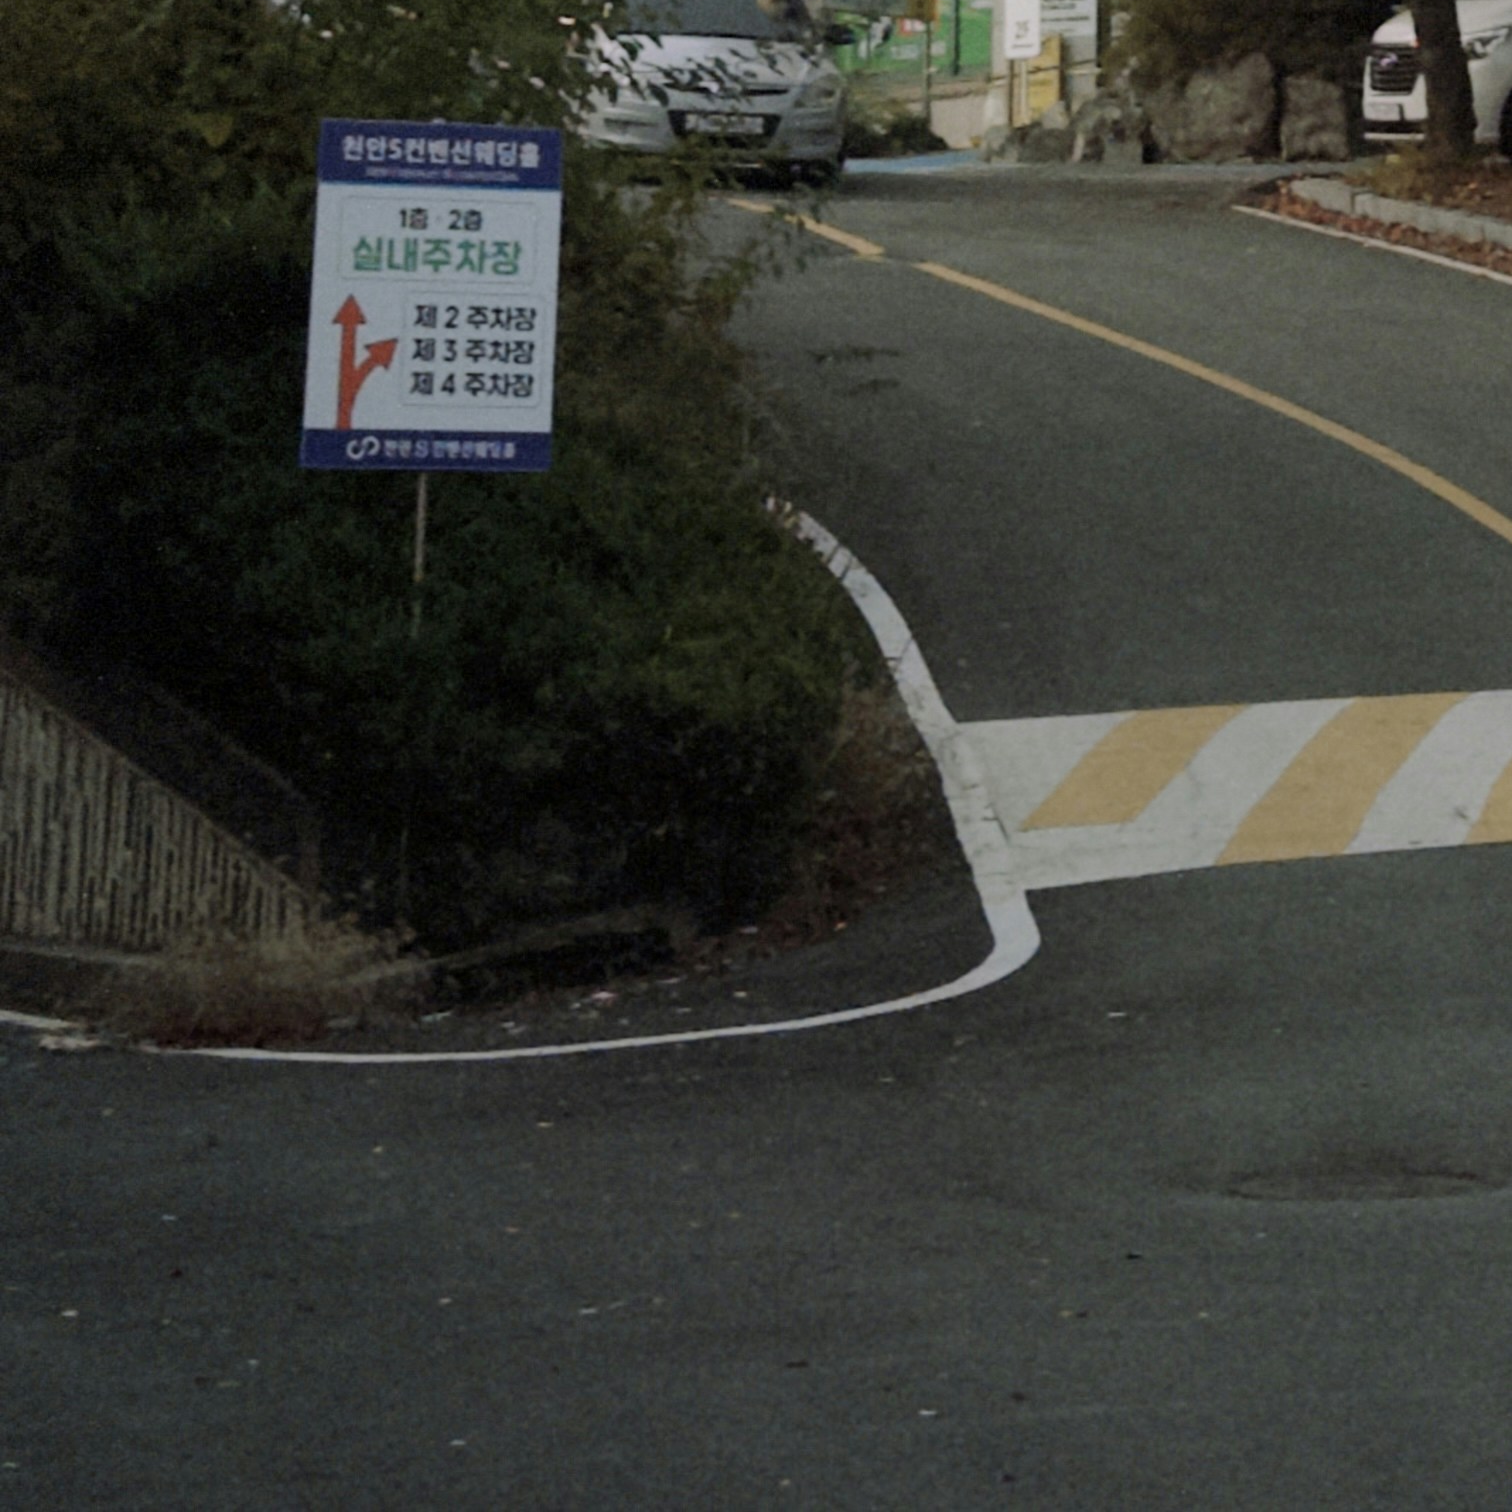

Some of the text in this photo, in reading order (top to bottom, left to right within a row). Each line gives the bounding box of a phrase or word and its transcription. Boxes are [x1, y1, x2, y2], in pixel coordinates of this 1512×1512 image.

[352, 236, 523, 276] 실내주차장
[413, 304, 537, 332] 제 2 주차장
[411, 337, 536, 365] 제 3 주차장
[409, 371, 535, 398] 제 4 주차장
